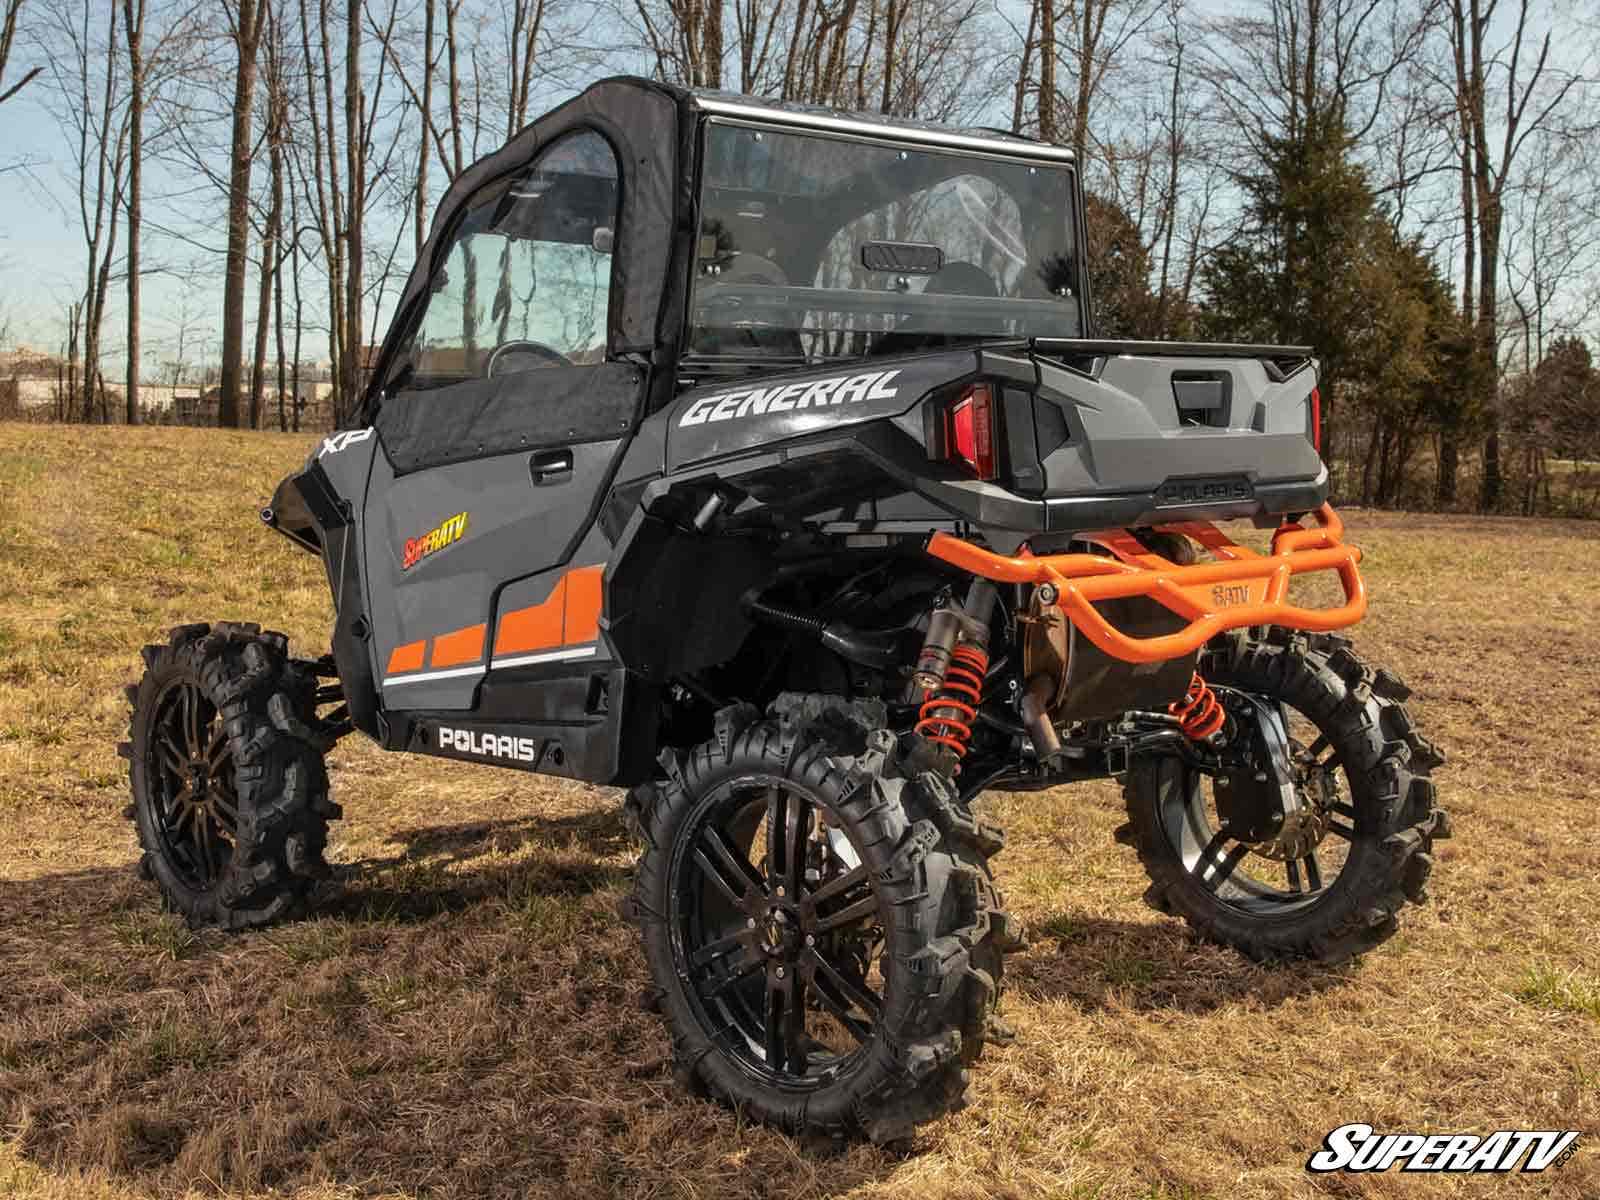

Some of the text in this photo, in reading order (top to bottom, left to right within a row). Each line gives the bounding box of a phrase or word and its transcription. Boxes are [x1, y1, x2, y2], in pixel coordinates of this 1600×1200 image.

[679, 369, 902, 427] GENERAL
[318, 426, 375, 459] XP
[439, 727, 535, 761] POLARIS
